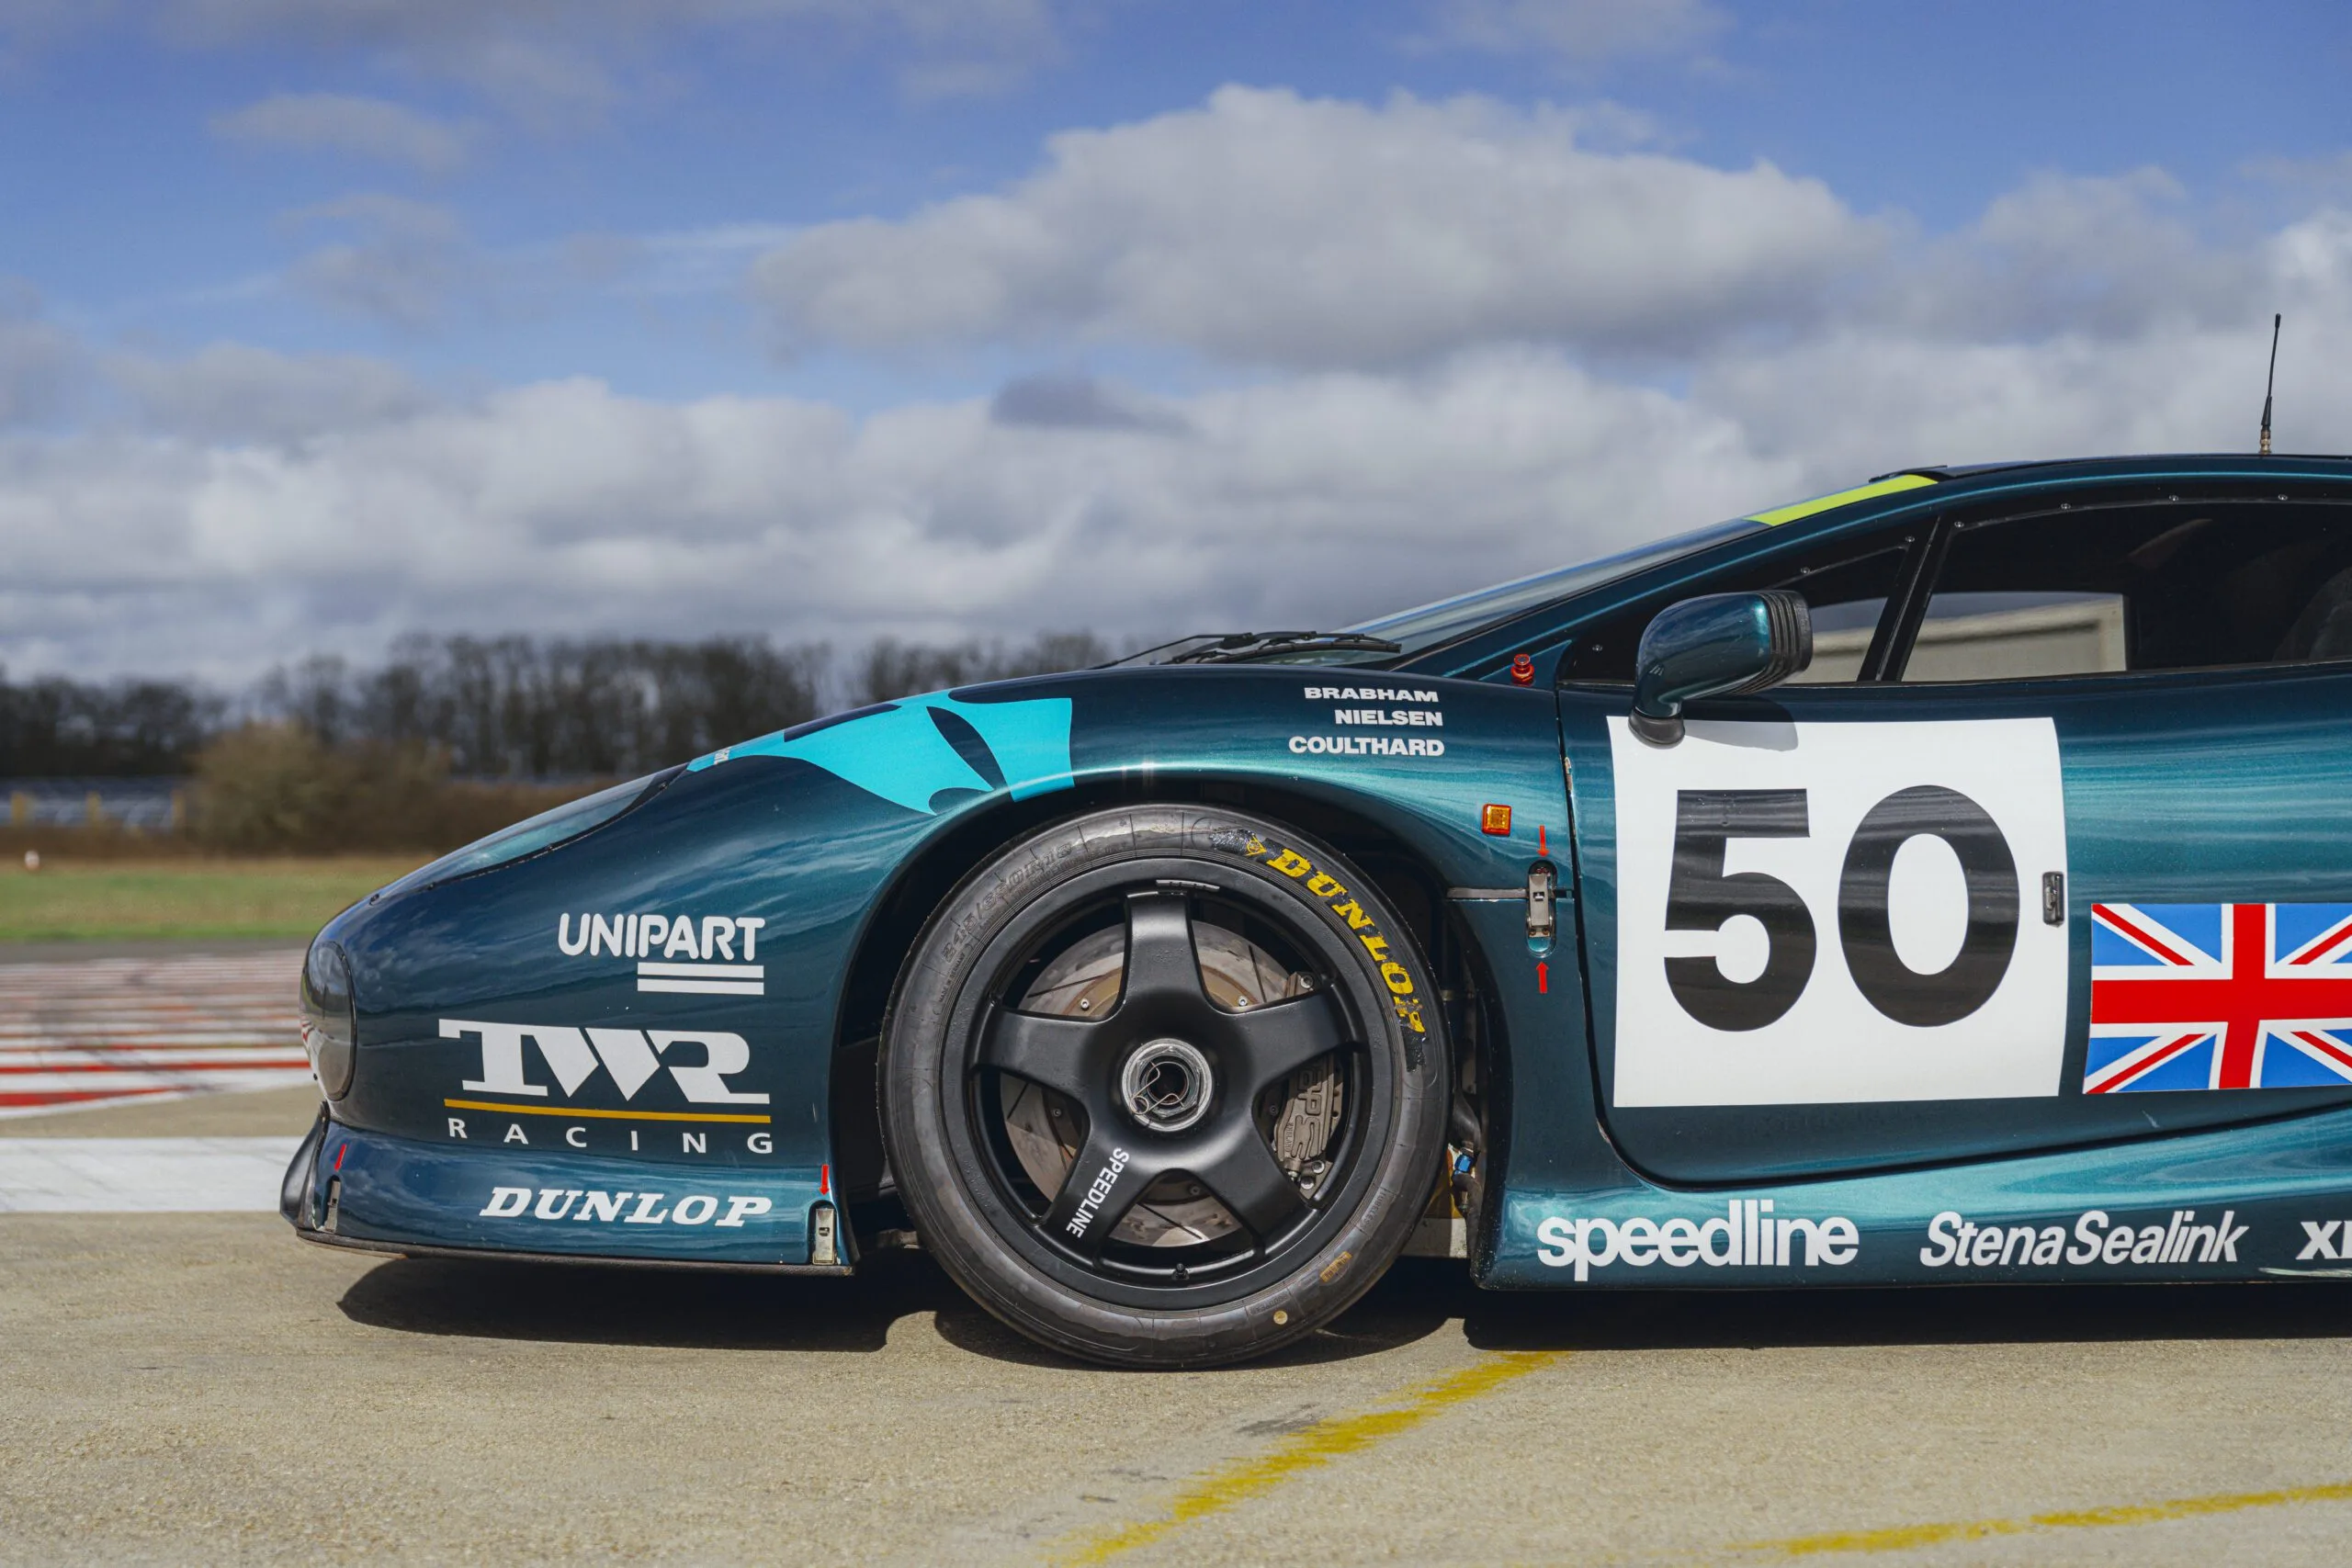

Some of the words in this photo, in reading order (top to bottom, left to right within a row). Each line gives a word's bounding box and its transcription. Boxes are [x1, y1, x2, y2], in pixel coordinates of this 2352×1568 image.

[1304, 687, 1439, 703] BRABHAM
[1334, 709, 1443, 727] NIELSEN
[1288, 735, 1445, 757] COULTHARD
[1664, 784, 2020, 1032] 50
[558, 913, 765, 960] UNIPART
[1266, 847, 1426, 1032] DUNLOP
[438, 1019, 771, 1104] TWR
[447, 1117, 773, 1155] RACING
[479, 1186, 773, 1227] DUNLOP
[1066, 1147, 1130, 1238] SPEEDLINE
[1536, 1198, 1860, 1281] speedline
